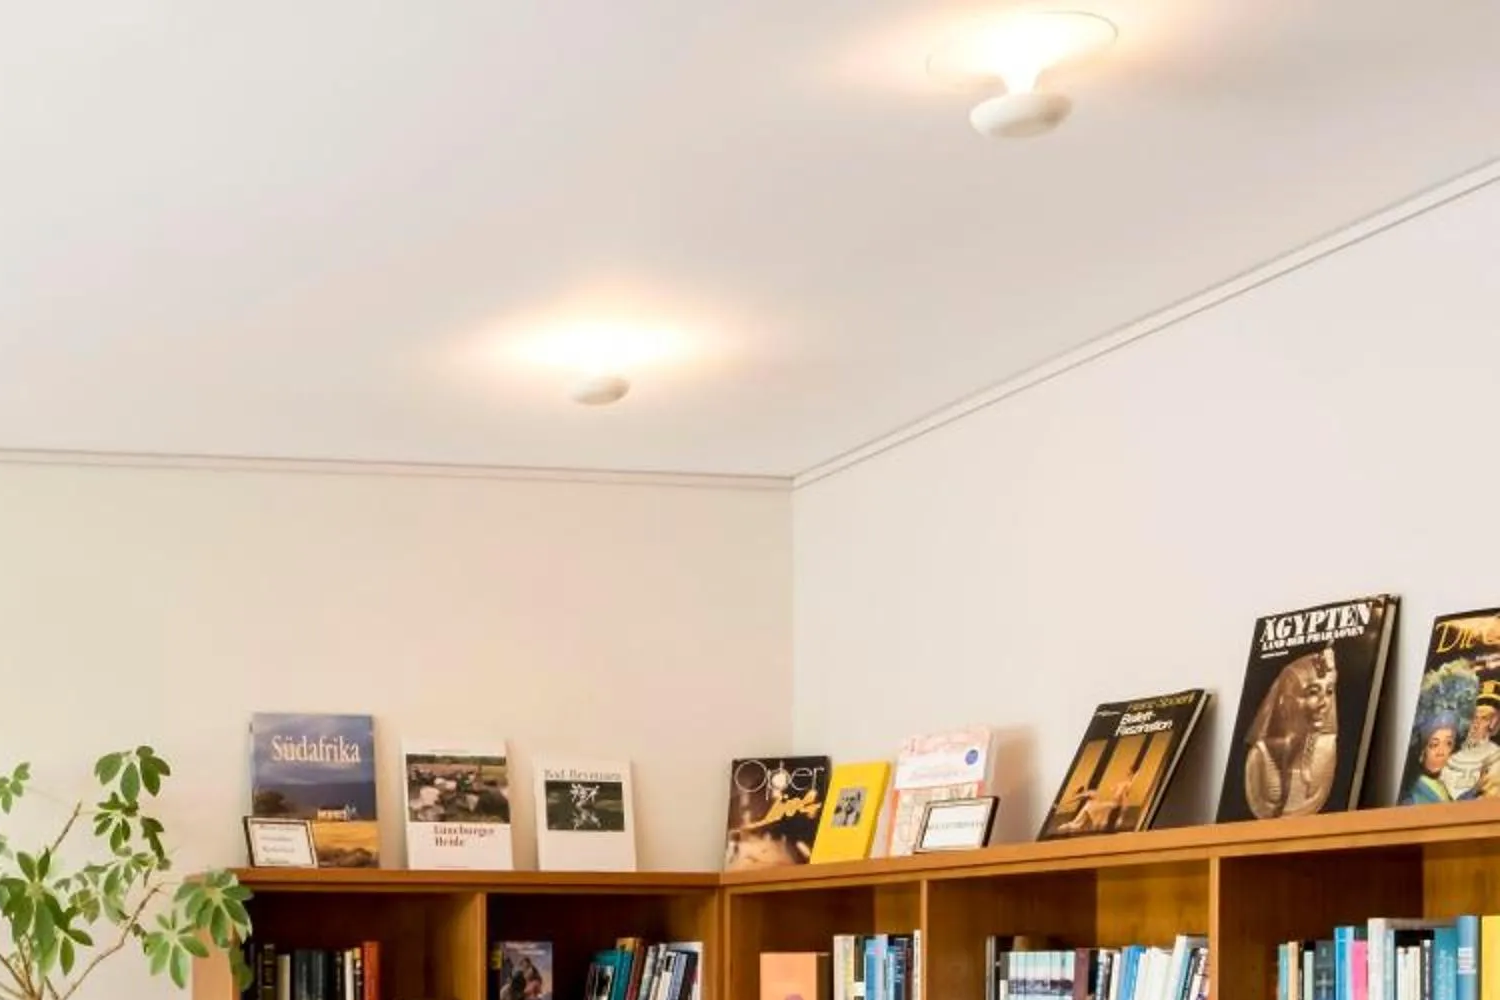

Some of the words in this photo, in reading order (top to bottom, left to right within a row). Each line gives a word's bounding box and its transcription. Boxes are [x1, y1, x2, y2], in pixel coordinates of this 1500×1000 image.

[1260, 601, 1373, 642] ÄGYPTEN
[271, 734, 362, 763] Südafrika
[734, 758, 825, 800] Oper
